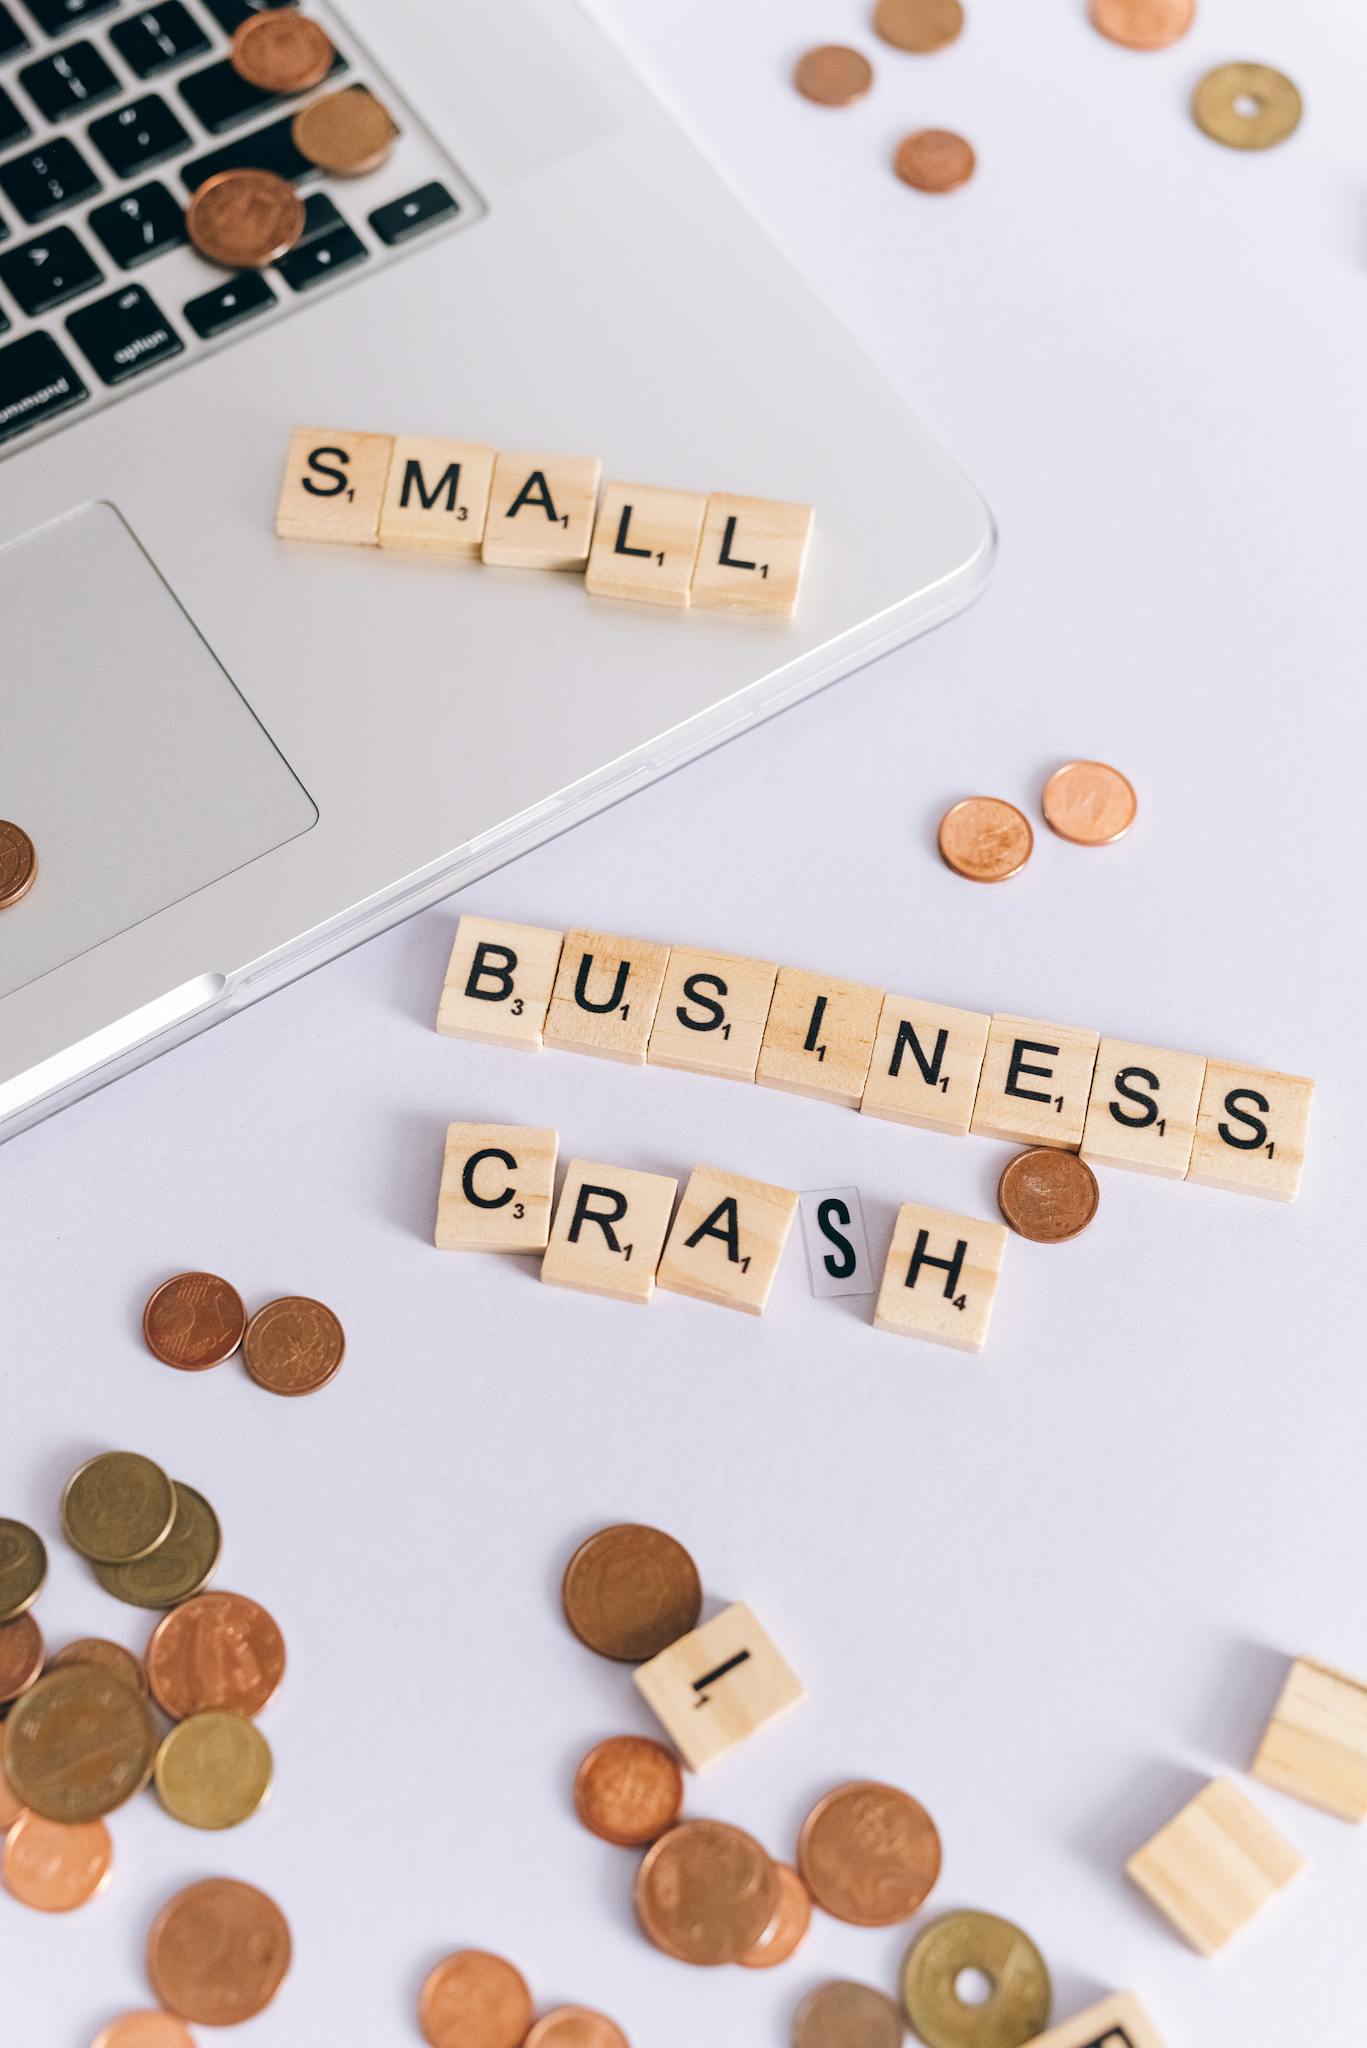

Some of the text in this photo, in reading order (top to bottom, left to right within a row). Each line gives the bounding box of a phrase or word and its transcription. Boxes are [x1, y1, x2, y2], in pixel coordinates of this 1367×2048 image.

[0, 376, 69, 424] ommand
[113, 329, 168, 364] option
[301, 446, 758, 571] SMALL
[347, 488, 769, 579] 1 3 1 1 1
[465, 942, 1270, 1150] BUSINESS
[510, 998, 1275, 1160] 3 1 1 1 1 1 1 1
[462, 1148, 968, 1300] CRASH
[512, 1203, 966, 1311] 3 1 1 4
